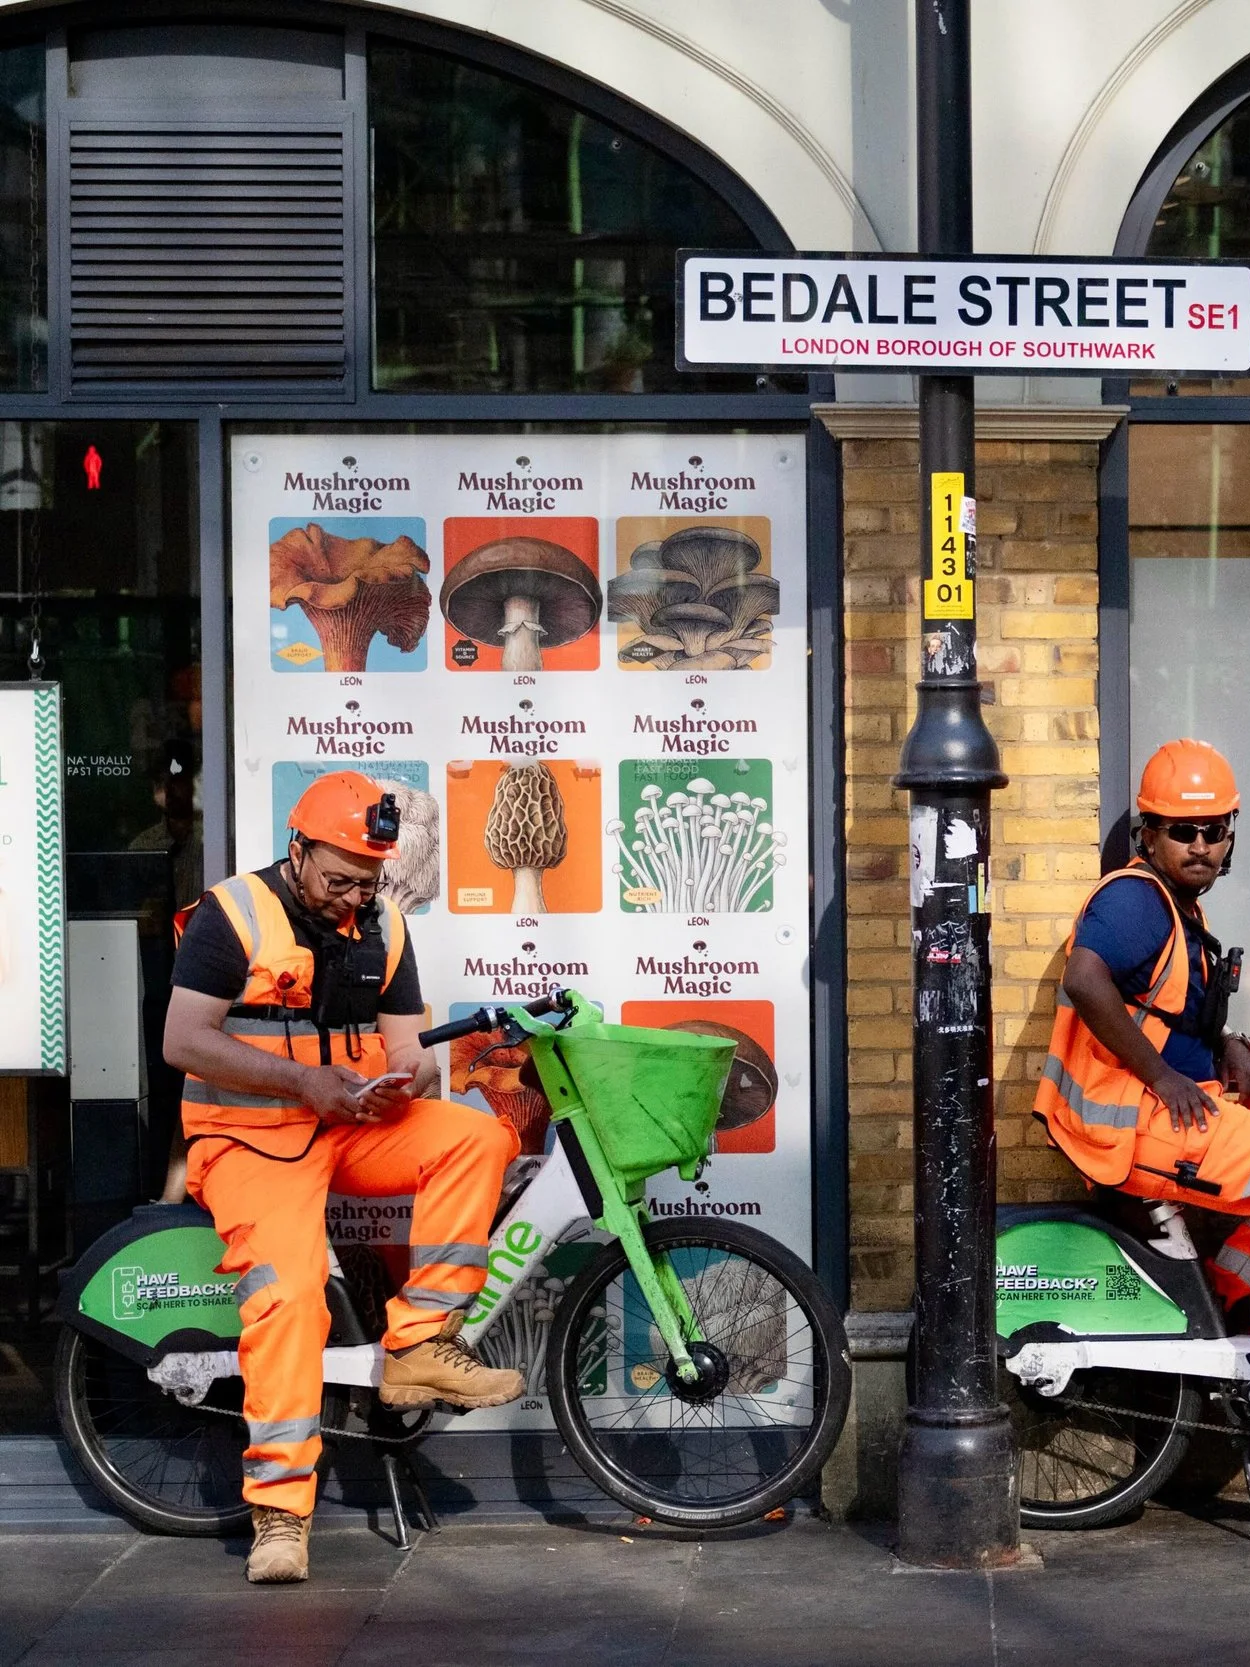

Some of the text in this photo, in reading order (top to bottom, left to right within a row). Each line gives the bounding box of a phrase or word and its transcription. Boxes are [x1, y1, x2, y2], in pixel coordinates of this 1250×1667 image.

[700, 271, 1240, 331] BEDALE STREET SE1
[781, 338, 1156, 360] LONDON BOROUGH OF SOUTHWARK
[283, 470, 411, 492] Mushroom
[457, 470, 584, 492] Mushroom
[630, 469, 756, 492] Mushroom
[312, 492, 383, 514] Magic
[486, 492, 556, 514] Magic
[659, 491, 728, 513] Magic
[937, 584, 962, 603] 01
[339, 676, 363, 686] LEON
[513, 676, 536, 685] LEON
[685, 675, 708, 684] LEON
[286, 714, 414, 737] Mushroom
[460, 714, 586, 736] Mushroom
[633, 712, 758, 734] Mushroom
[315, 736, 386, 758] Magic
[489, 736, 559, 757] Magic
[661, 735, 730, 756] Magic
[67, 766, 131, 777] FAST FOOD
[667, 765, 699, 774] FOOD
[516, 918, 539, 928] LEON
[687, 917, 710, 926] LEON
[463, 956, 589, 977] Mushroom
[635, 954, 760, 975] Mushroom
[663, 976, 732, 997] Magic
[325, 1200, 413, 1219] shroom
[326, 1219, 391, 1242] Magic
[136, 1272, 180, 1287] HAVE
[995, 1265, 1039, 1278] HAVE
[136, 1282, 237, 1301] FEEDBACK?
[995, 1278, 1099, 1292] FEEDBACK?
[136, 1296, 236, 1312] SCAN HERE TO SHARE.
[995, 1292, 1096, 1301] SCAN HERE TO SHARE.
[520, 1400, 543, 1410] LEON
